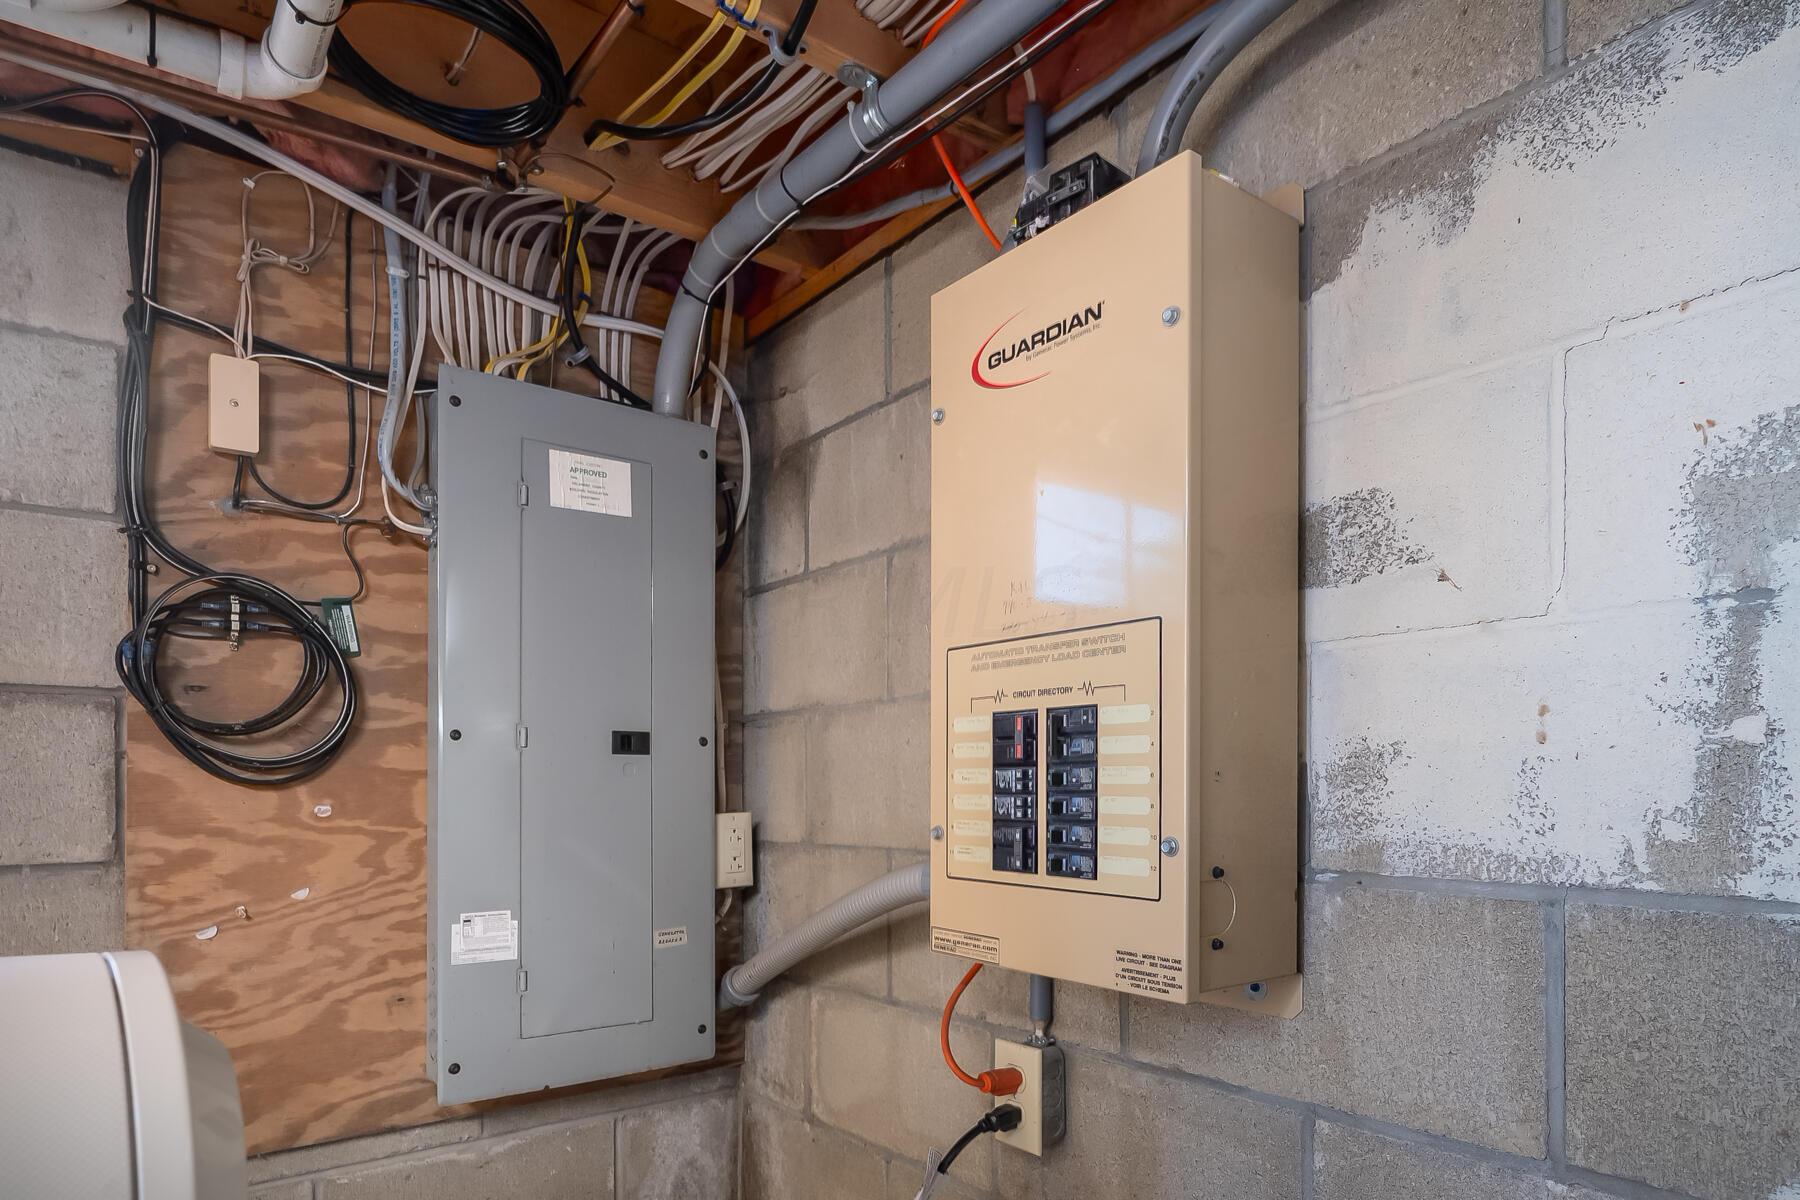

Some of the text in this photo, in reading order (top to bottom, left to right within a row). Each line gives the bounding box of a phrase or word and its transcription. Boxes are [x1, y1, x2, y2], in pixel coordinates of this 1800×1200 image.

[988, 301, 1102, 370] GUARDIAN
[570, 466, 608, 478] APPROVED
[970, 632, 1126, 662] AUTOMATIC TRANSFER SWITCH
[970, 644, 1127, 672] AND EMERGENCY LOAD CENTER
[1012, 686, 1074, 699] CIRCUIT DIRECTORY
[934, 935, 998, 952] www.generac.com
[1121, 968, 1159, 978] AVERTISSEMENT
[1160, 964, 1182, 972] DIAGRAM
[1149, 986, 1169, 994] SCHEMA
[1161, 981, 1182, 990] TENSION
